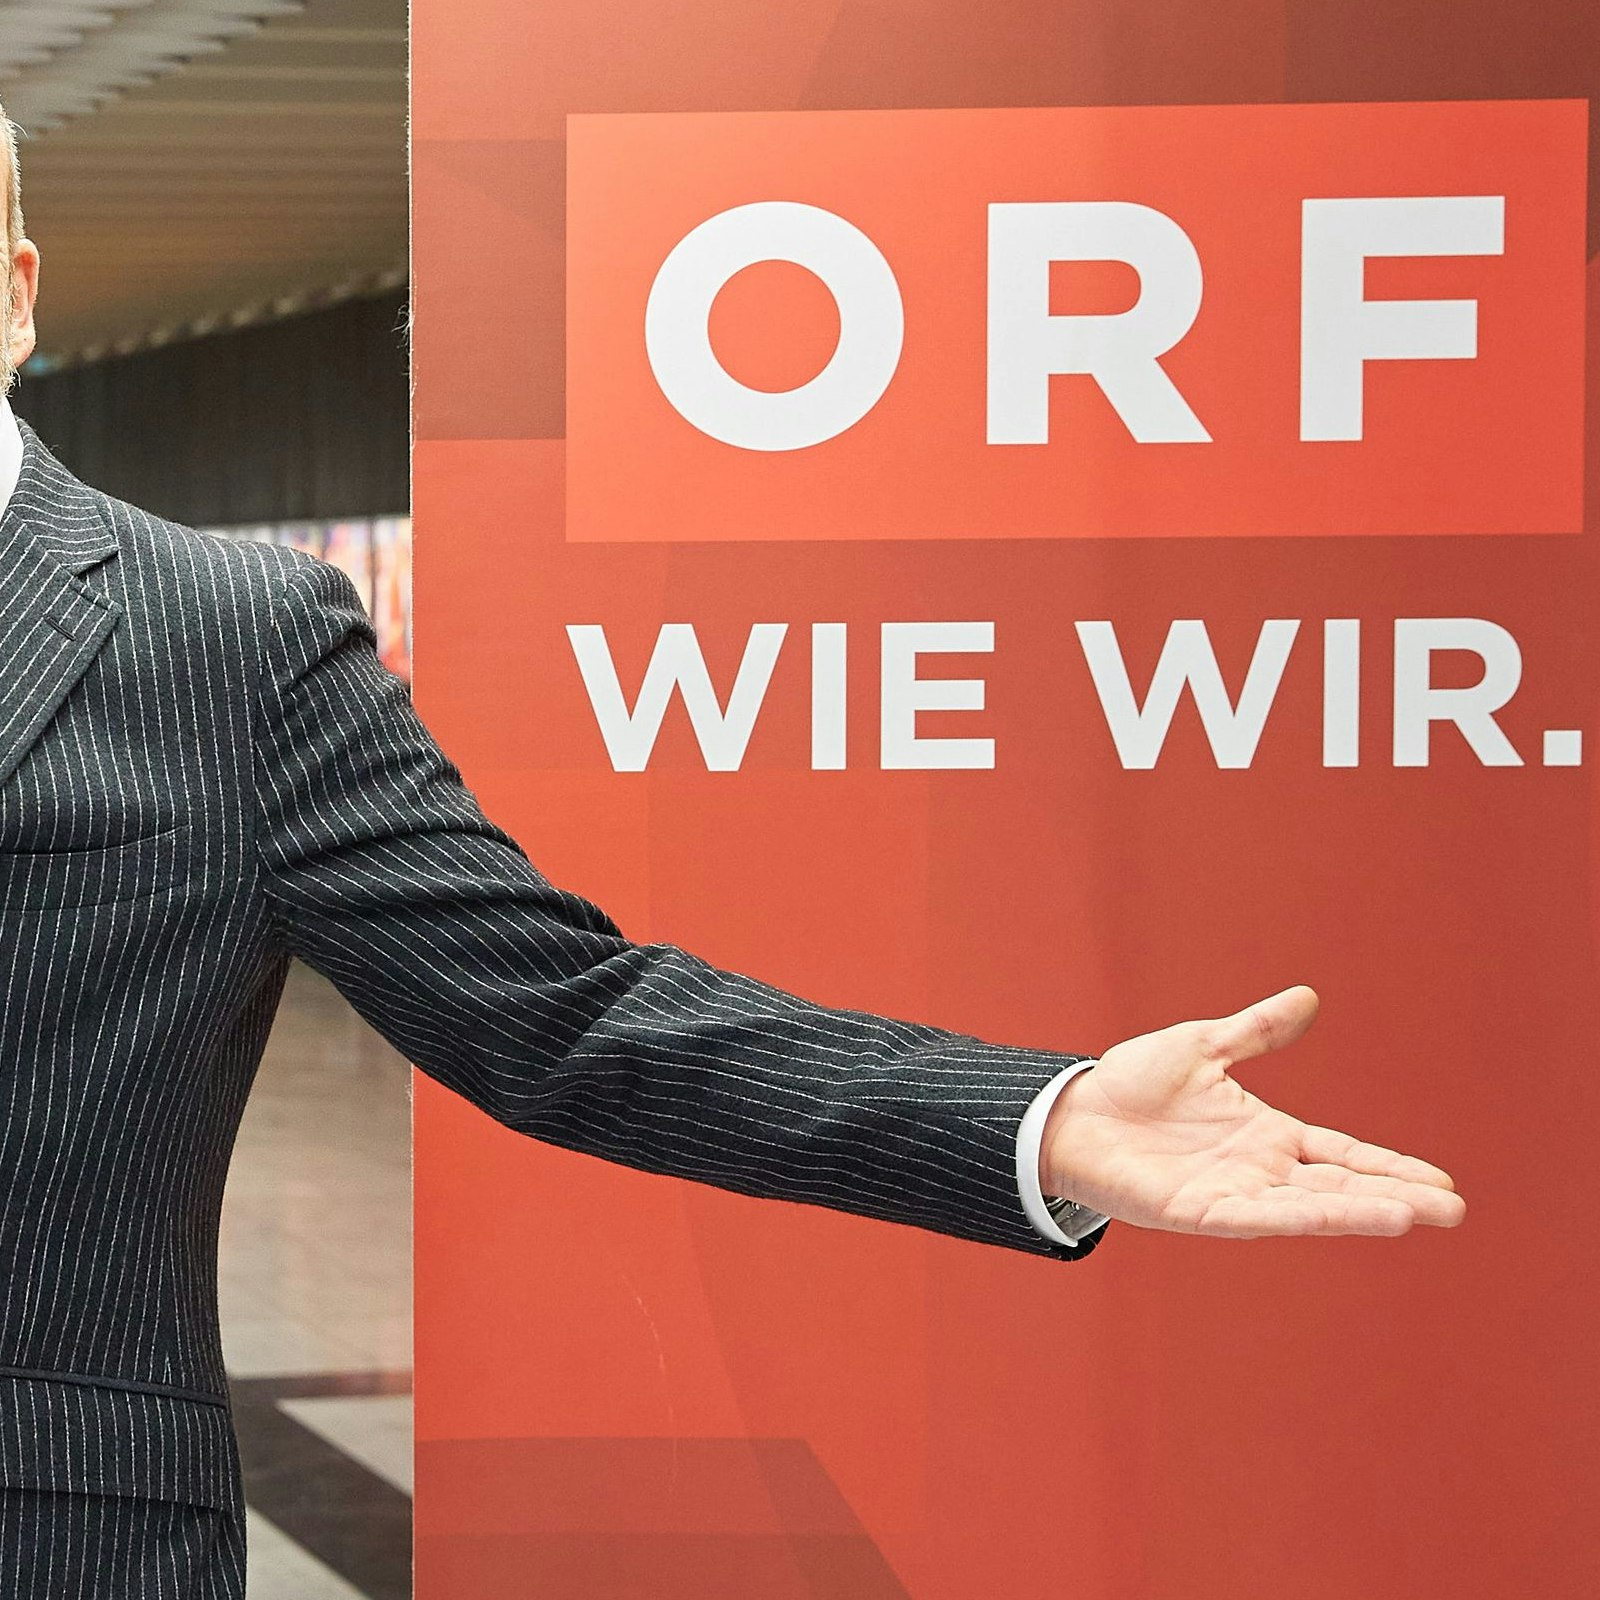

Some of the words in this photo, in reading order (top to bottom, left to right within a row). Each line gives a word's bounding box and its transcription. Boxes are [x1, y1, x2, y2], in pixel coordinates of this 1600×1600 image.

[644, 195, 1505, 452] ORF
[565, 621, 996, 773] WIE
[1074, 617, 1582, 770] WIR.
